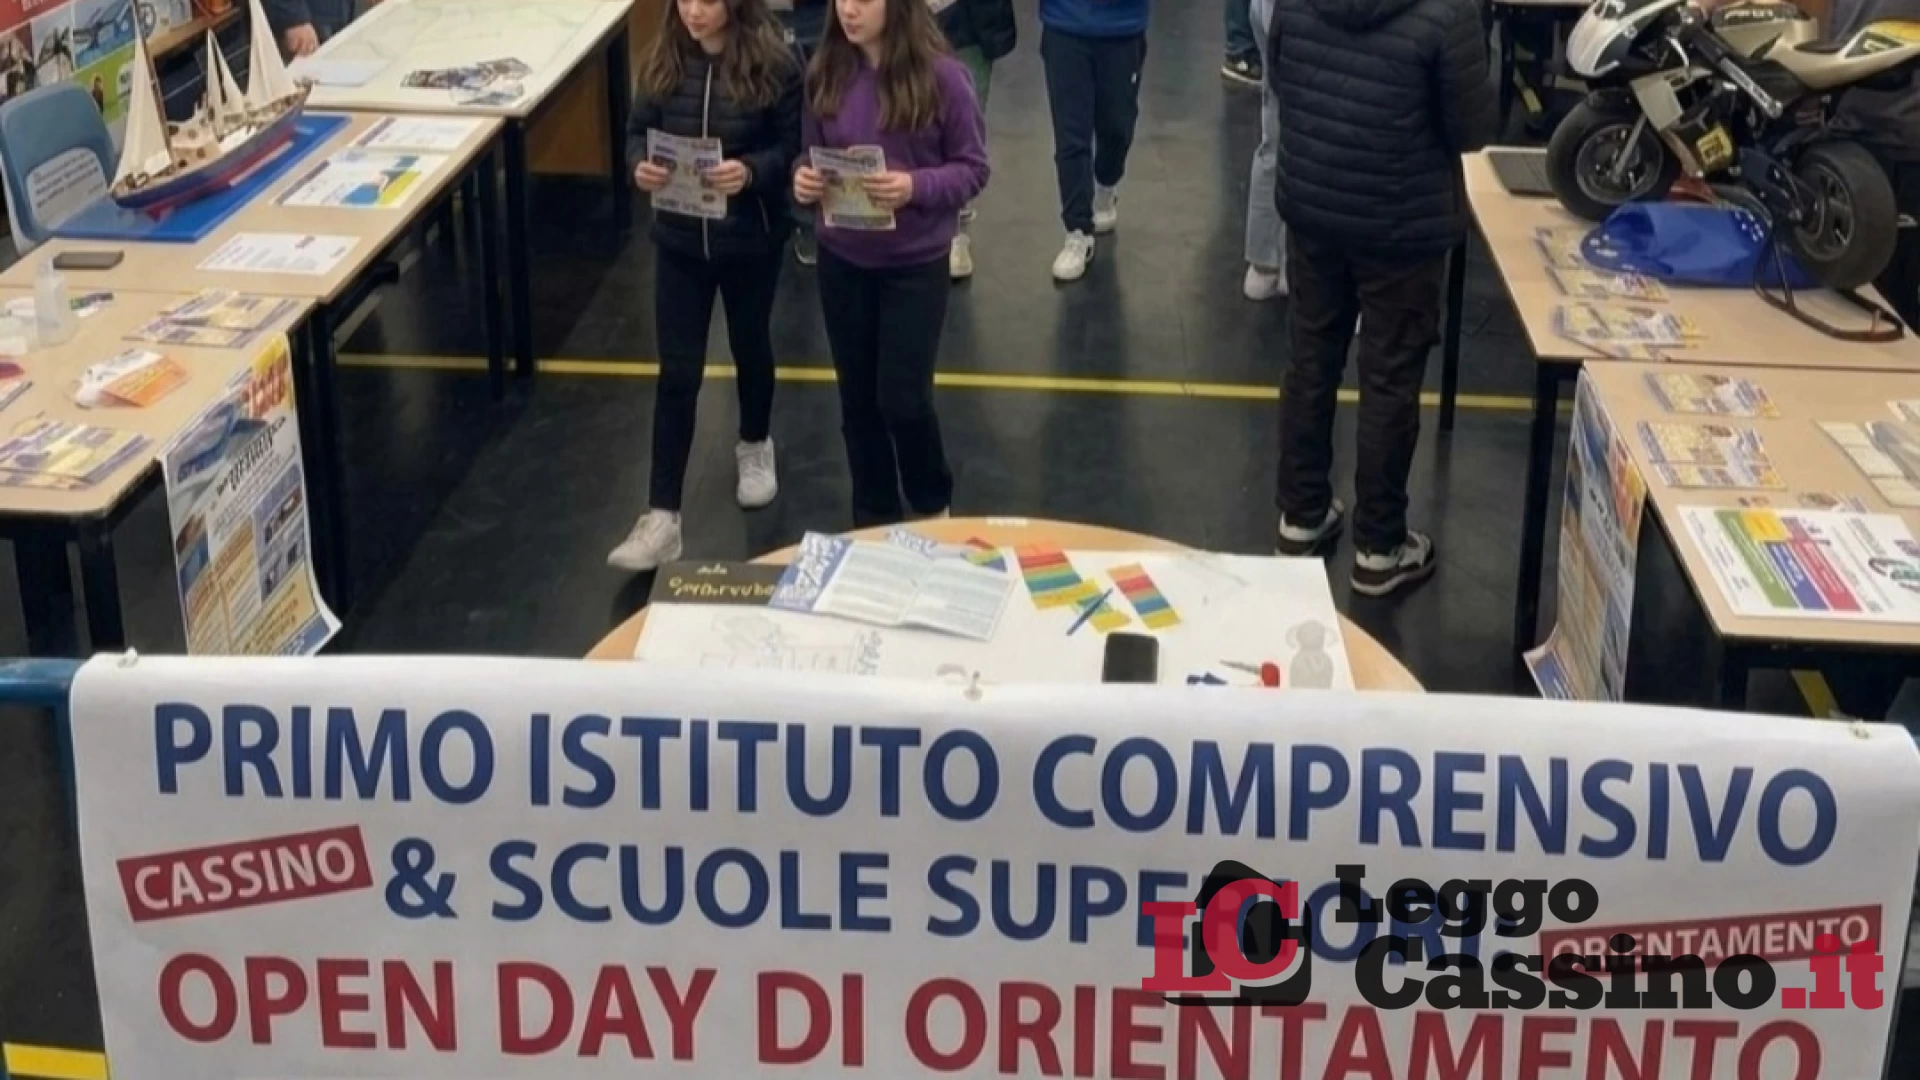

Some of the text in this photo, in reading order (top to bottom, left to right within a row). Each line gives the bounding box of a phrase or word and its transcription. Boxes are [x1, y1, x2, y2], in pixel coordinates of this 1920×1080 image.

[155, 703, 1838, 866] PRIMO ISTITUTO COMPRENSIVO
[133, 838, 356, 911] CASSINO
[385, 837, 458, 920] &
[490, 840, 891, 932] SCUOLE
[159, 953, 1822, 1080] OPEN DAY DI ORIENTAMENTO
